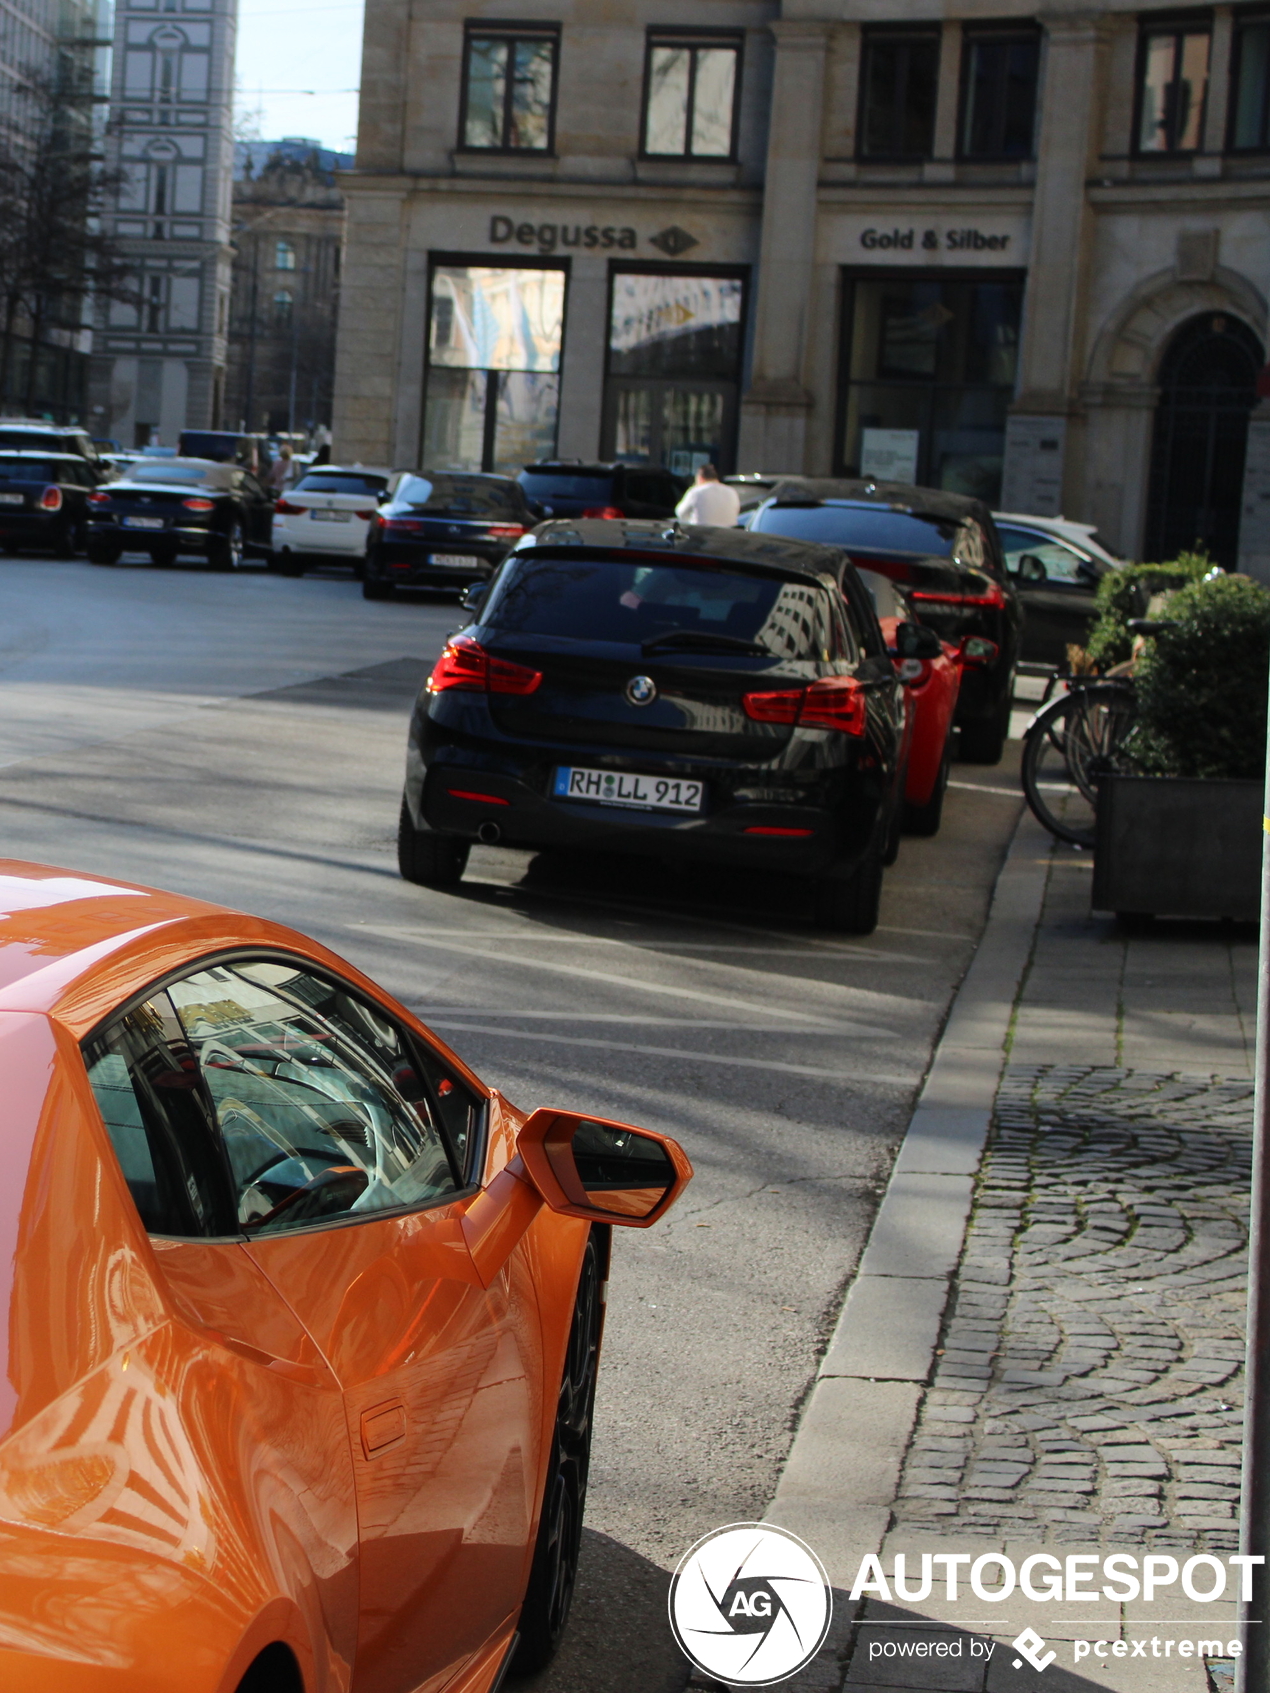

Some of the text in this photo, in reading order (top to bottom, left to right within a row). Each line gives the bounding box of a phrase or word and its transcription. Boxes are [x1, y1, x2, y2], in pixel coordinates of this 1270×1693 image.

[489, 214, 638, 253] Degussa
[860, 228, 1010, 250] Gold & Silber
[569, 770, 602, 795] RH
[617, 776, 648, 800] LL
[655, 781, 700, 806] 912
